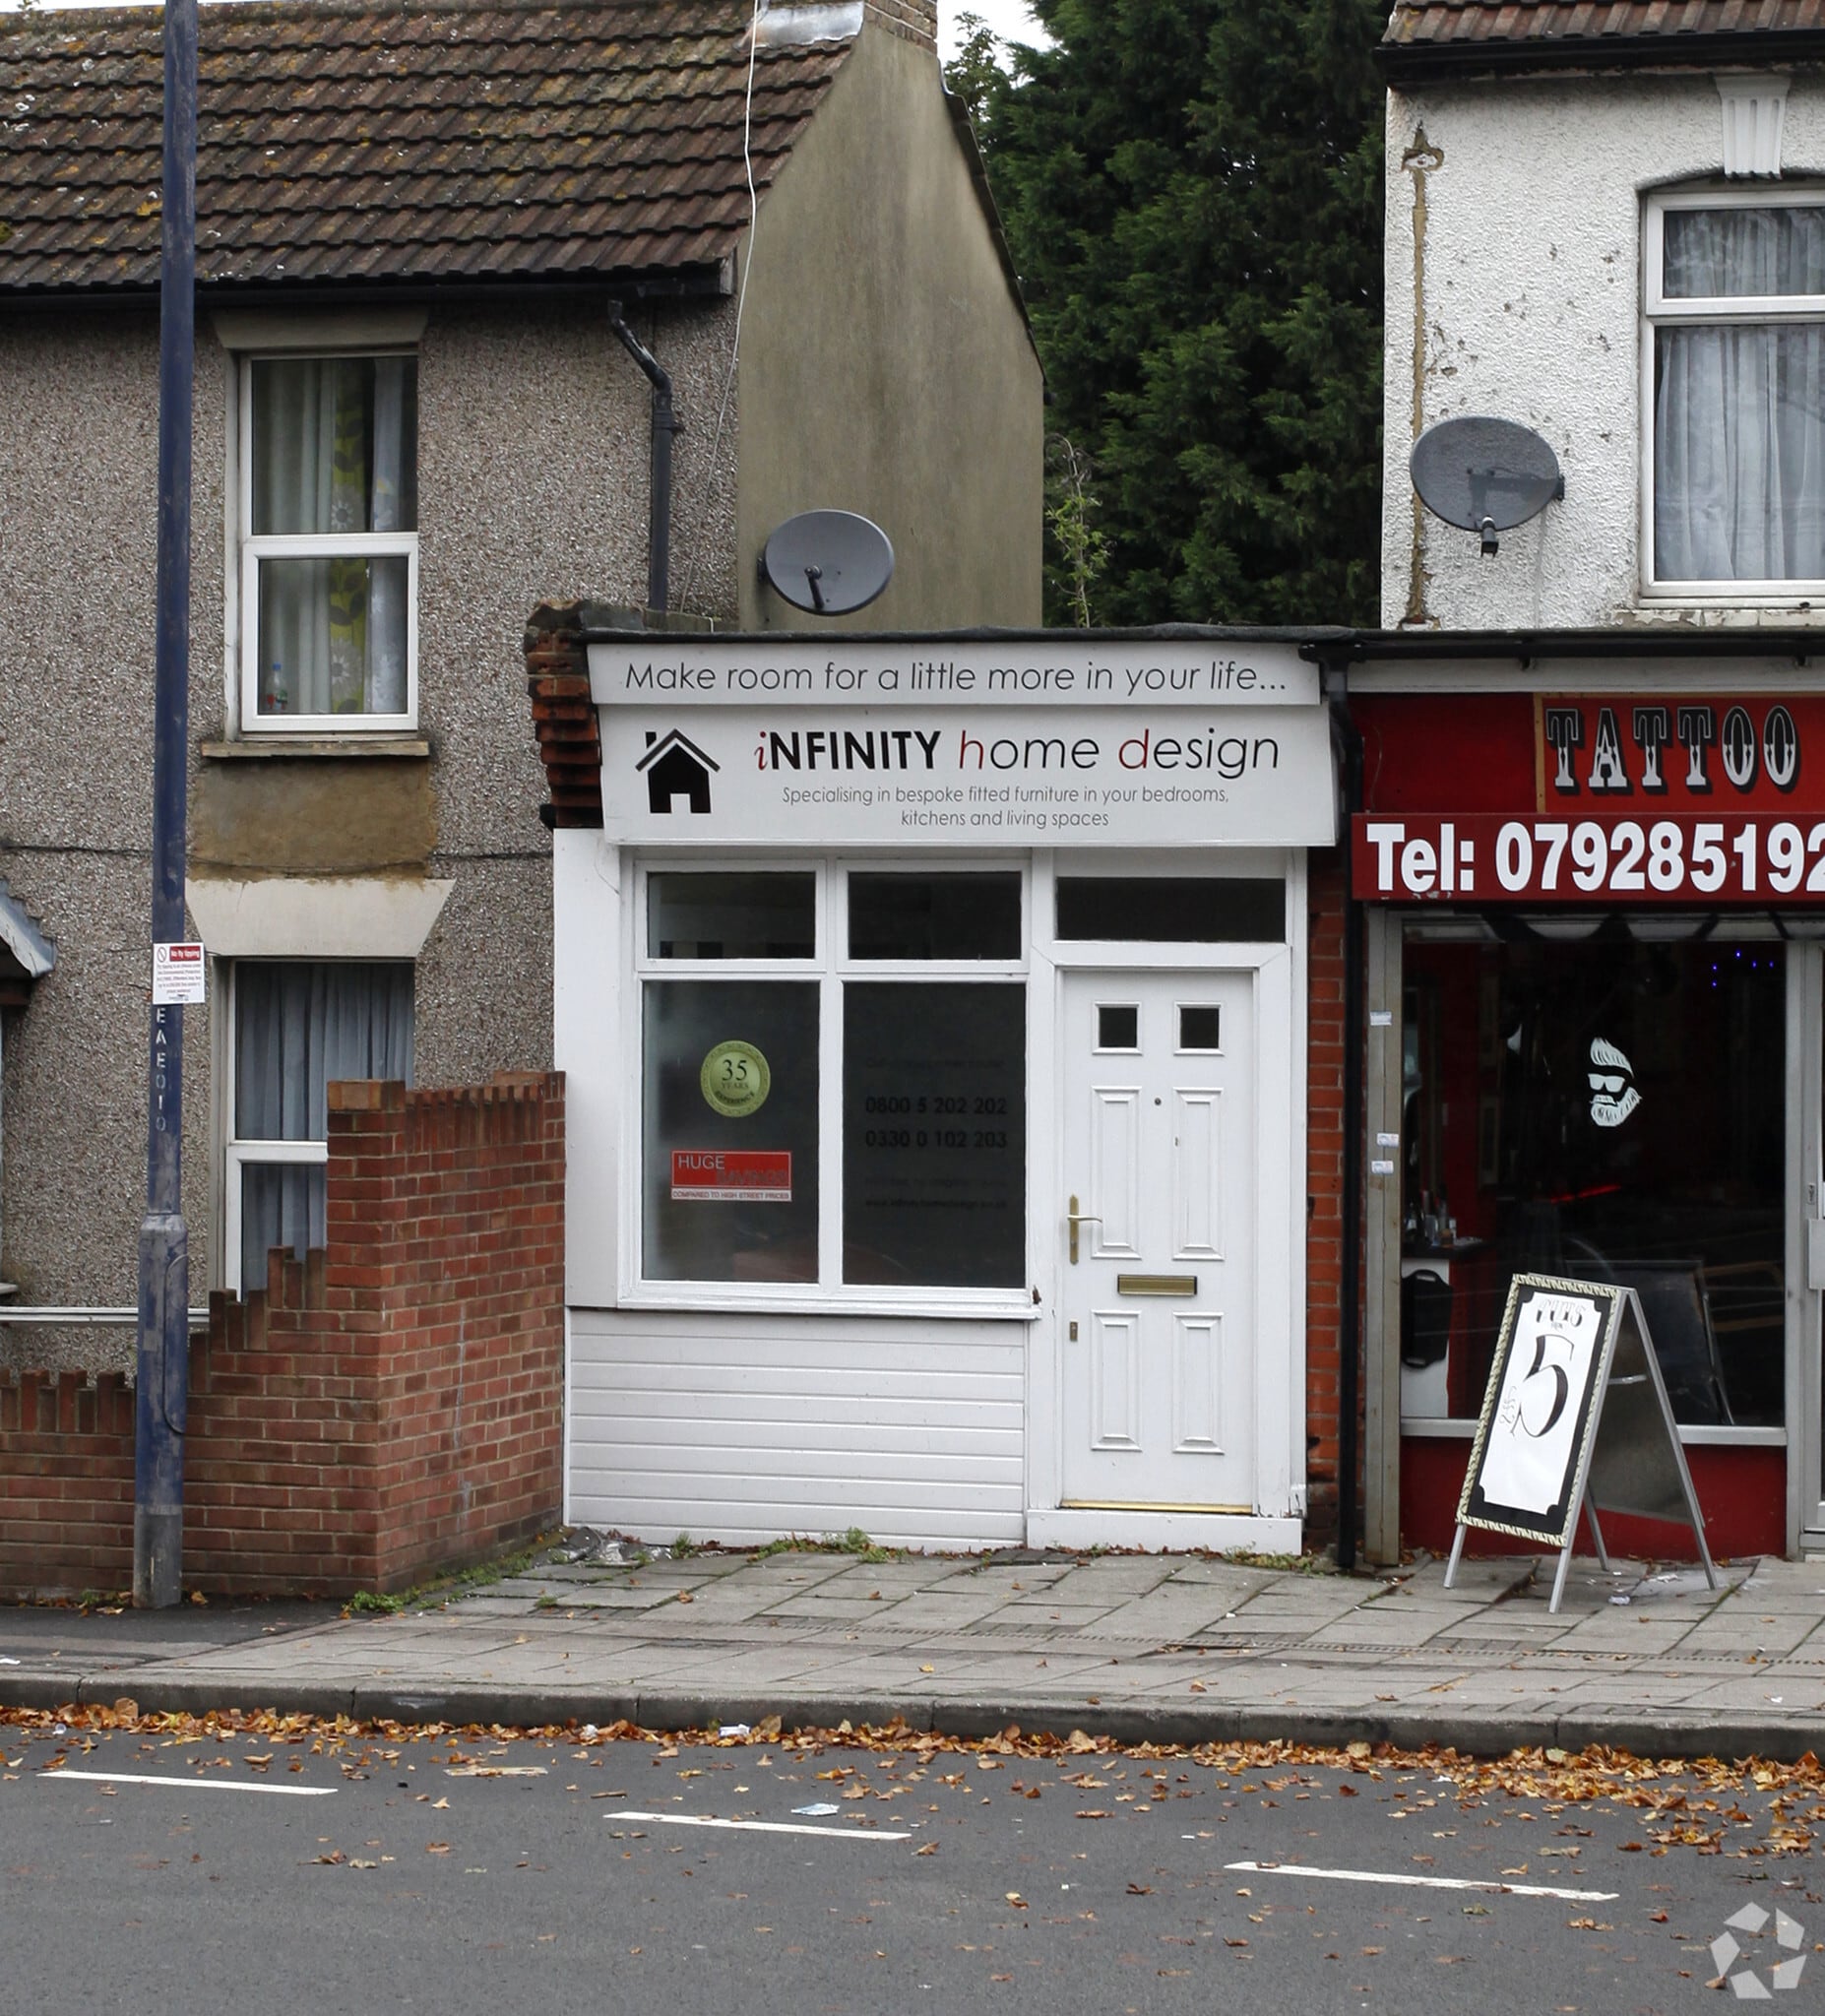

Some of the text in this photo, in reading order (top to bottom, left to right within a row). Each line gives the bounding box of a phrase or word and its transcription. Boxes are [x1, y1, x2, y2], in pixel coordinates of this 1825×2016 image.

[626, 662, 1286, 696] Make room for a little more in your life...
[754, 727, 1279, 780] iNFINITY home design
[1545, 705, 1799, 793] TATTOO
[783, 787, 1228, 806] Specialising in bespoke fitted furniture in your bedrooms,
[902, 810, 1109, 830] kitchens and living spaces
[1366, 821, 1475, 893] Tel:
[722, 1059, 747, 1081] 35
[865, 1097, 1008, 1114] 0800 5 202 202
[865, 1130, 1007, 1148] 0330 0 102 203
[678, 1155, 725, 1169] HUGE
